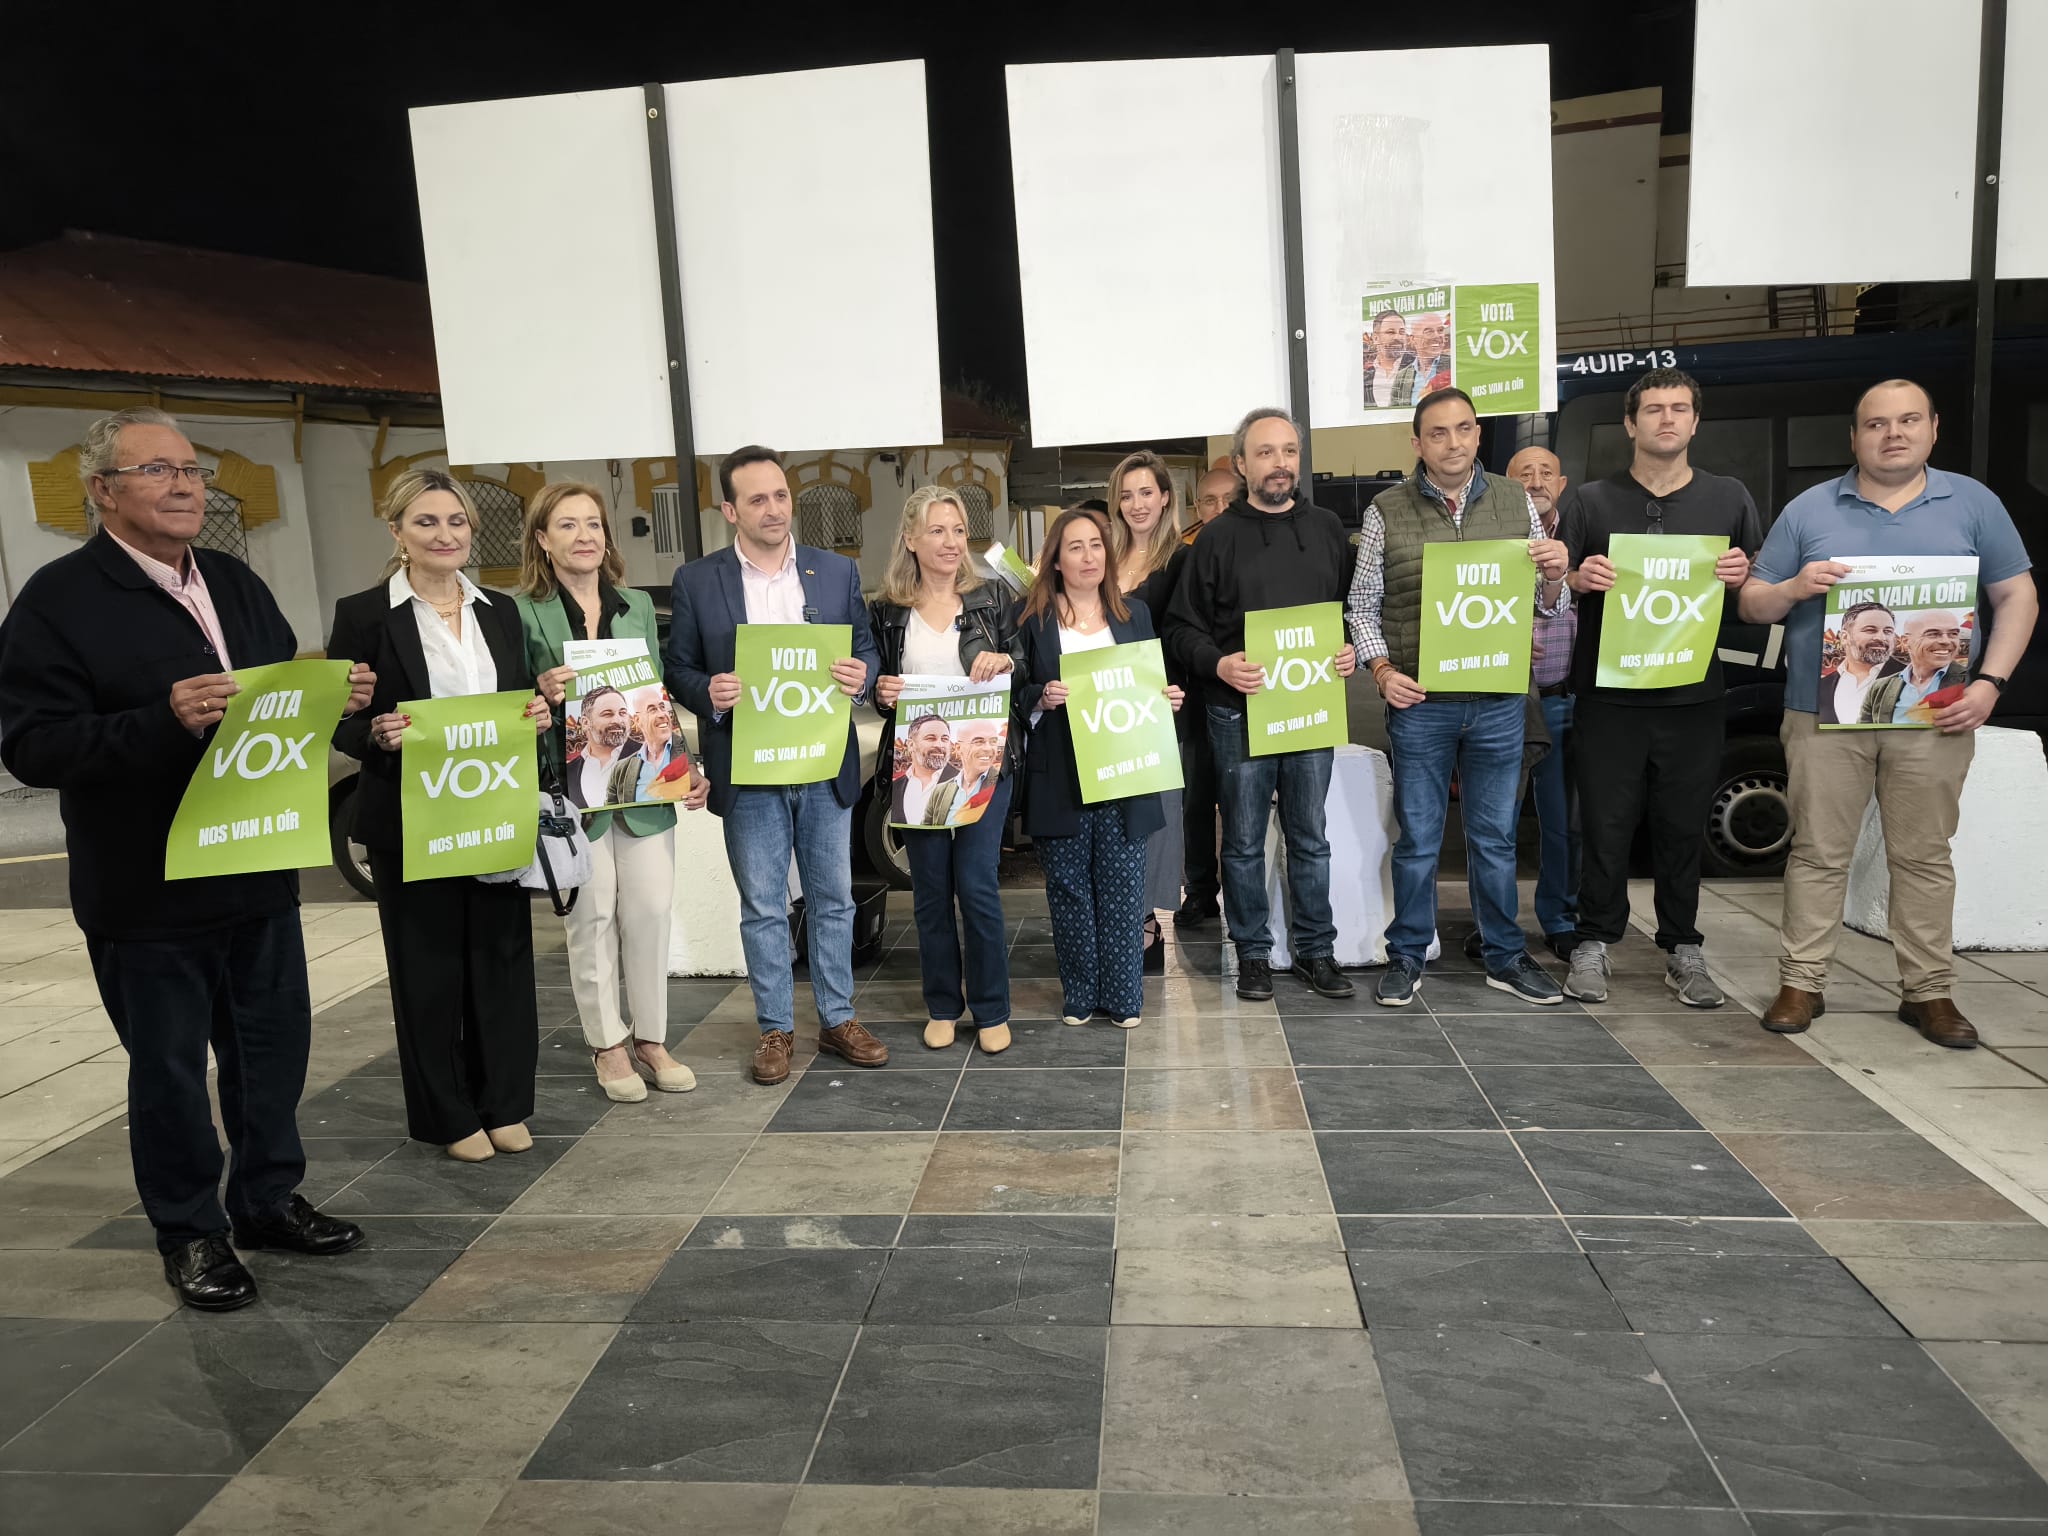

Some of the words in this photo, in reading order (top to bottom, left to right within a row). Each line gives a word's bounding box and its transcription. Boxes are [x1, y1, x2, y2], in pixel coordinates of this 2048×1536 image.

[1369, 299, 1391, 317] NOS
[1394, 295, 1415, 312] VAN
[1417, 294, 1425, 310] A
[1427, 288, 1446, 308] OÍR
[1481, 303, 1514, 322] VOTA
[1467, 328, 1528, 360] VOX
[1572, 350, 1677, 374] 4UIP-13
[1471, 385, 1486, 398] NOS
[1489, 383, 1503, 395] VAN
[1504, 382, 1511, 393] A
[1511, 376, 1524, 392] OÍR
[1456, 563, 1501, 586] VOTA
[1643, 557, 1691, 581] VOTA
[1891, 563, 1915, 575] VOX
[1620, 585, 1708, 627] VOX
[1838, 588, 1874, 610] NOS
[1879, 585, 1915, 607] VAN
[1918, 584, 1931, 605] A
[1935, 577, 1967, 604] OÍR
[1436, 591, 1519, 630] VOX
[1274, 626, 1315, 651] VOTA
[771, 648, 817, 671] VOTA
[1439, 658, 1459, 673] NOS
[1460, 656, 1481, 671] VAN
[1482, 656, 1490, 668] A
[1492, 651, 1510, 667] OÍR
[1620, 655, 1642, 668] NOS
[1643, 652, 1665, 667] VAN
[1666, 652, 1675, 664] A
[1677, 648, 1693, 663] OÍR
[576, 672, 606, 696] NOS
[606, 666, 629, 688] VAN
[627, 664, 639, 684] A
[635, 657, 655, 681] OÍR
[947, 684, 965, 692] VOX
[1091, 666, 1136, 693] VOTA
[1261, 656, 1332, 692] VOX
[248, 690, 303, 722] VOTA
[750, 677, 836, 717] VOX
[905, 703, 934, 721] NOS
[937, 700, 965, 718] VAN
[966, 698, 977, 715] A
[979, 693, 1003, 714] OÍR
[1081, 696, 1159, 734] VOX
[1267, 721, 1285, 736] NOS
[1287, 716, 1305, 732] VAN
[1306, 716, 1313, 728] A
[1314, 709, 1328, 725] OÍR
[444, 720, 498, 751] VOTA
[213, 730, 316, 780] VOX
[754, 748, 775, 763] NOS
[777, 746, 798, 761] VAN
[799, 745, 807, 759] A
[809, 741, 826, 757] OÍR
[1096, 765, 1115, 782] NOS
[1116, 759, 1135, 776] VAN
[1136, 757, 1144, 770] A
[1144, 751, 1160, 768] OÍR
[420, 756, 520, 799] VOX
[199, 825, 228, 847] NOS
[231, 818, 260, 841] VAN
[263, 816, 274, 835] A
[276, 808, 300, 833] OÍR
[428, 837, 454, 855] NOS
[456, 829, 481, 849] VAN
[484, 828, 493, 844] A
[495, 822, 515, 842] OÍR
